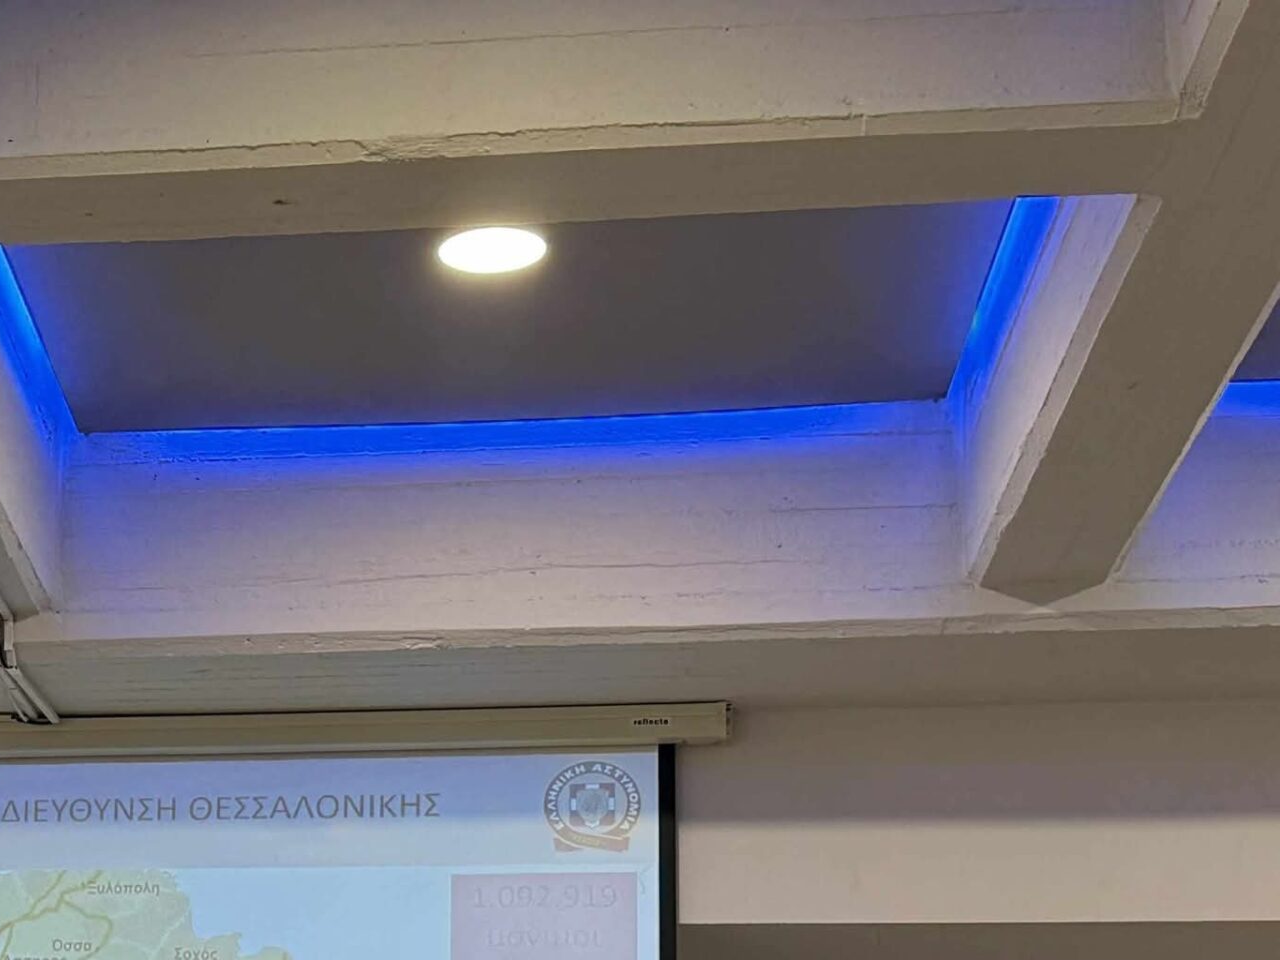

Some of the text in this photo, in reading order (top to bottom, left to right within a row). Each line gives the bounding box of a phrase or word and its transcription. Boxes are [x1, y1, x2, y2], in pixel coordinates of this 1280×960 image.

[0, 797, 176, 824] ΔΙΕΥΘΥΝΣΗ
[189, 793, 441, 821] ΘΕΣΣΑΛΟΝΙΚΗΣ
[591, 763, 639, 831] ΑΣΤΥΝΟΜΙΑ
